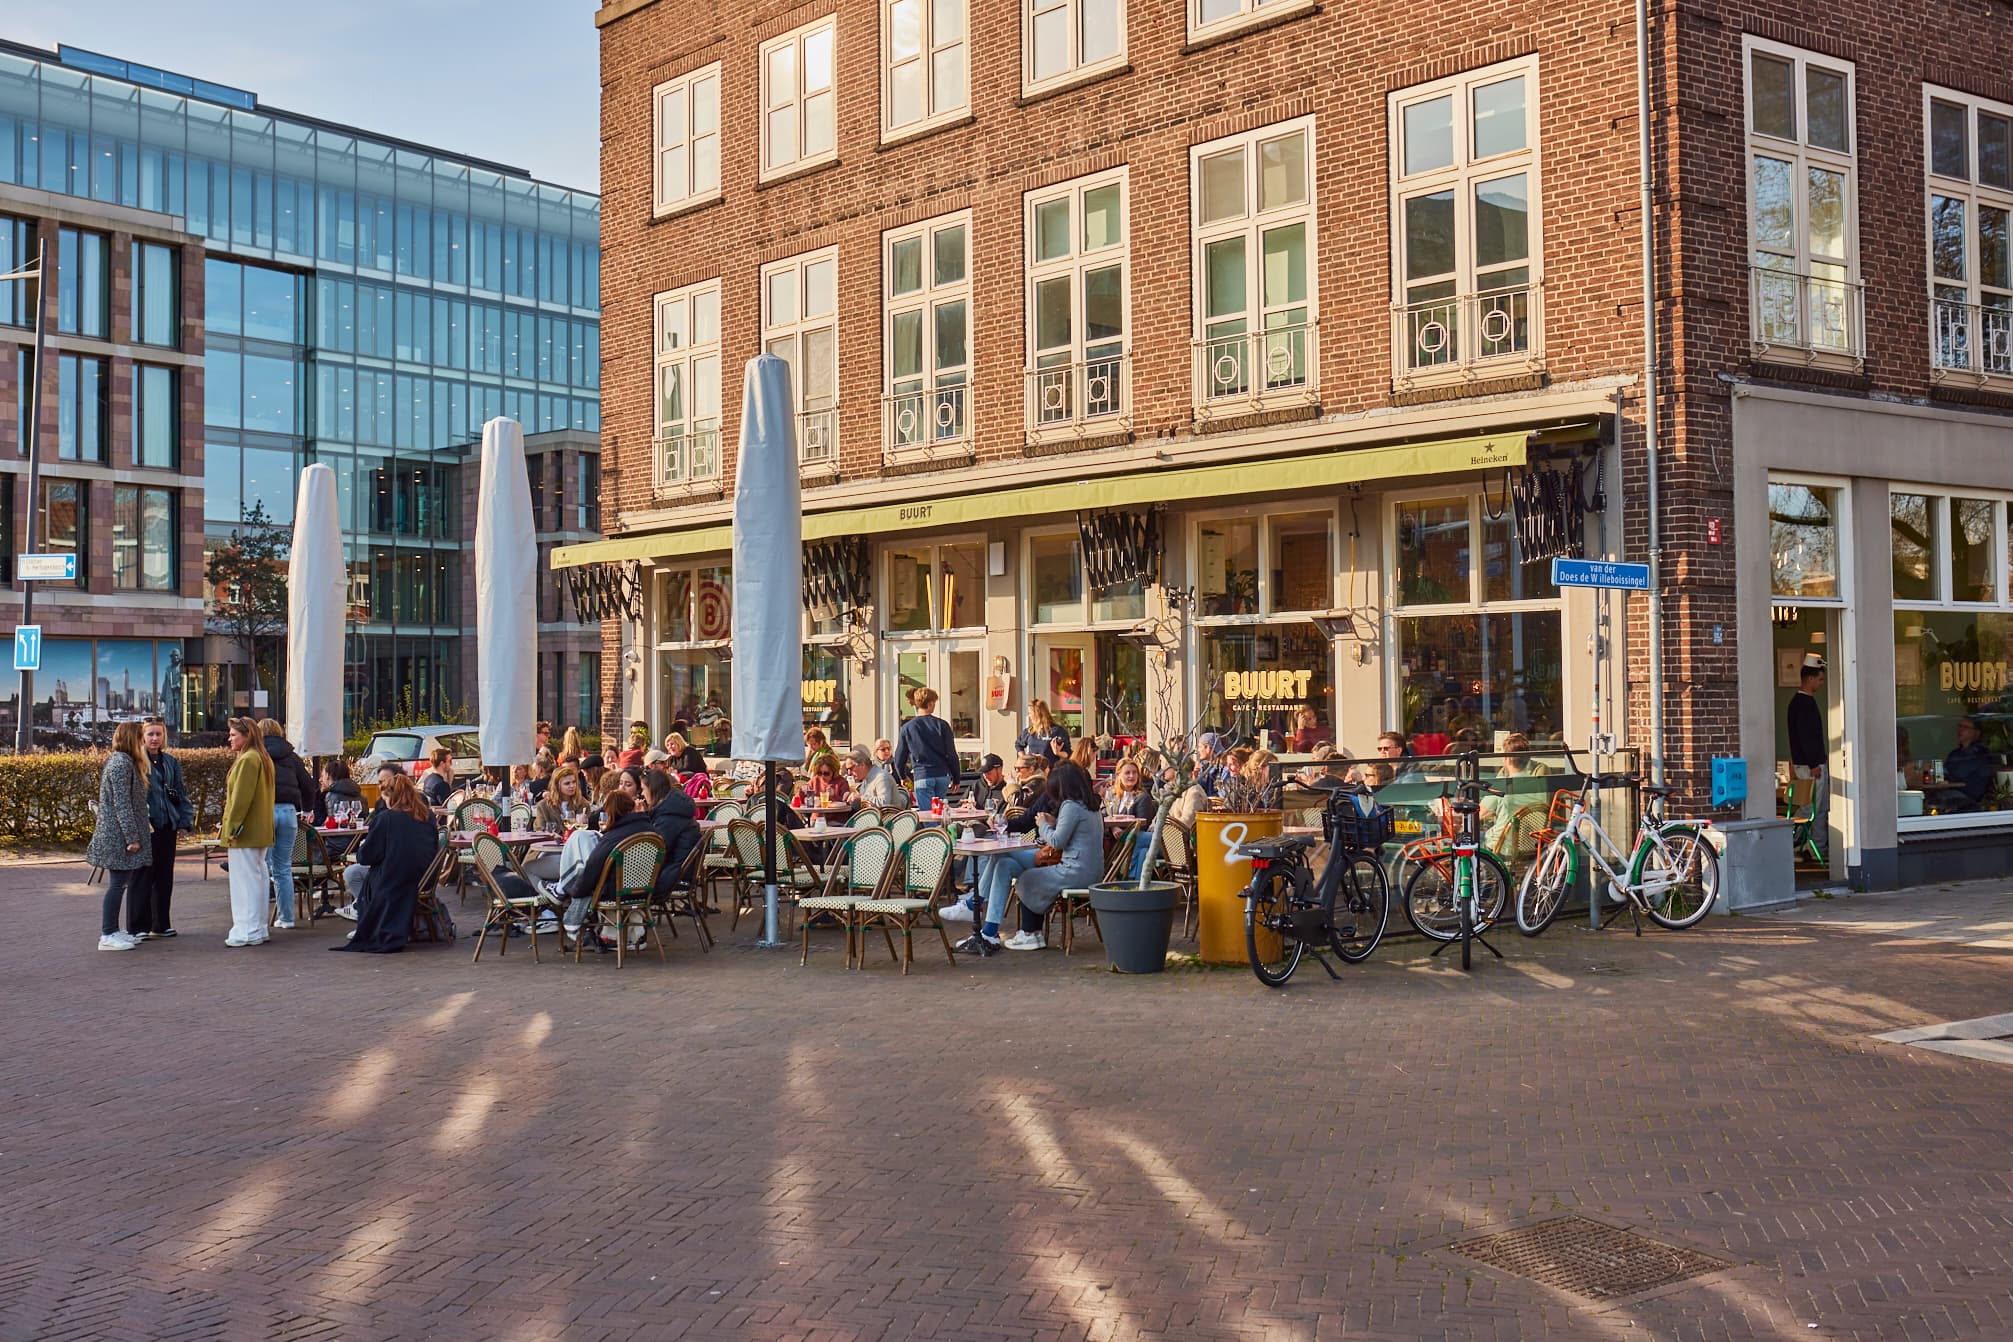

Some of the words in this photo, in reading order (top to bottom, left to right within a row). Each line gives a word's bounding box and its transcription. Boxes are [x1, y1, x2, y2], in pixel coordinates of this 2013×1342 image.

[1471, 455, 1508, 465] Heineken
[899, 505, 933, 520] BUURT
[1590, 565, 1603, 573] van
[1604, 563, 1617, 574] der
[1560, 571, 1578, 582] Does
[1580, 572, 1589, 583] de
[1940, 662, 2007, 691] BUURT
[800, 680, 837, 702] URT
[1224, 669, 1312, 700] BUURT
